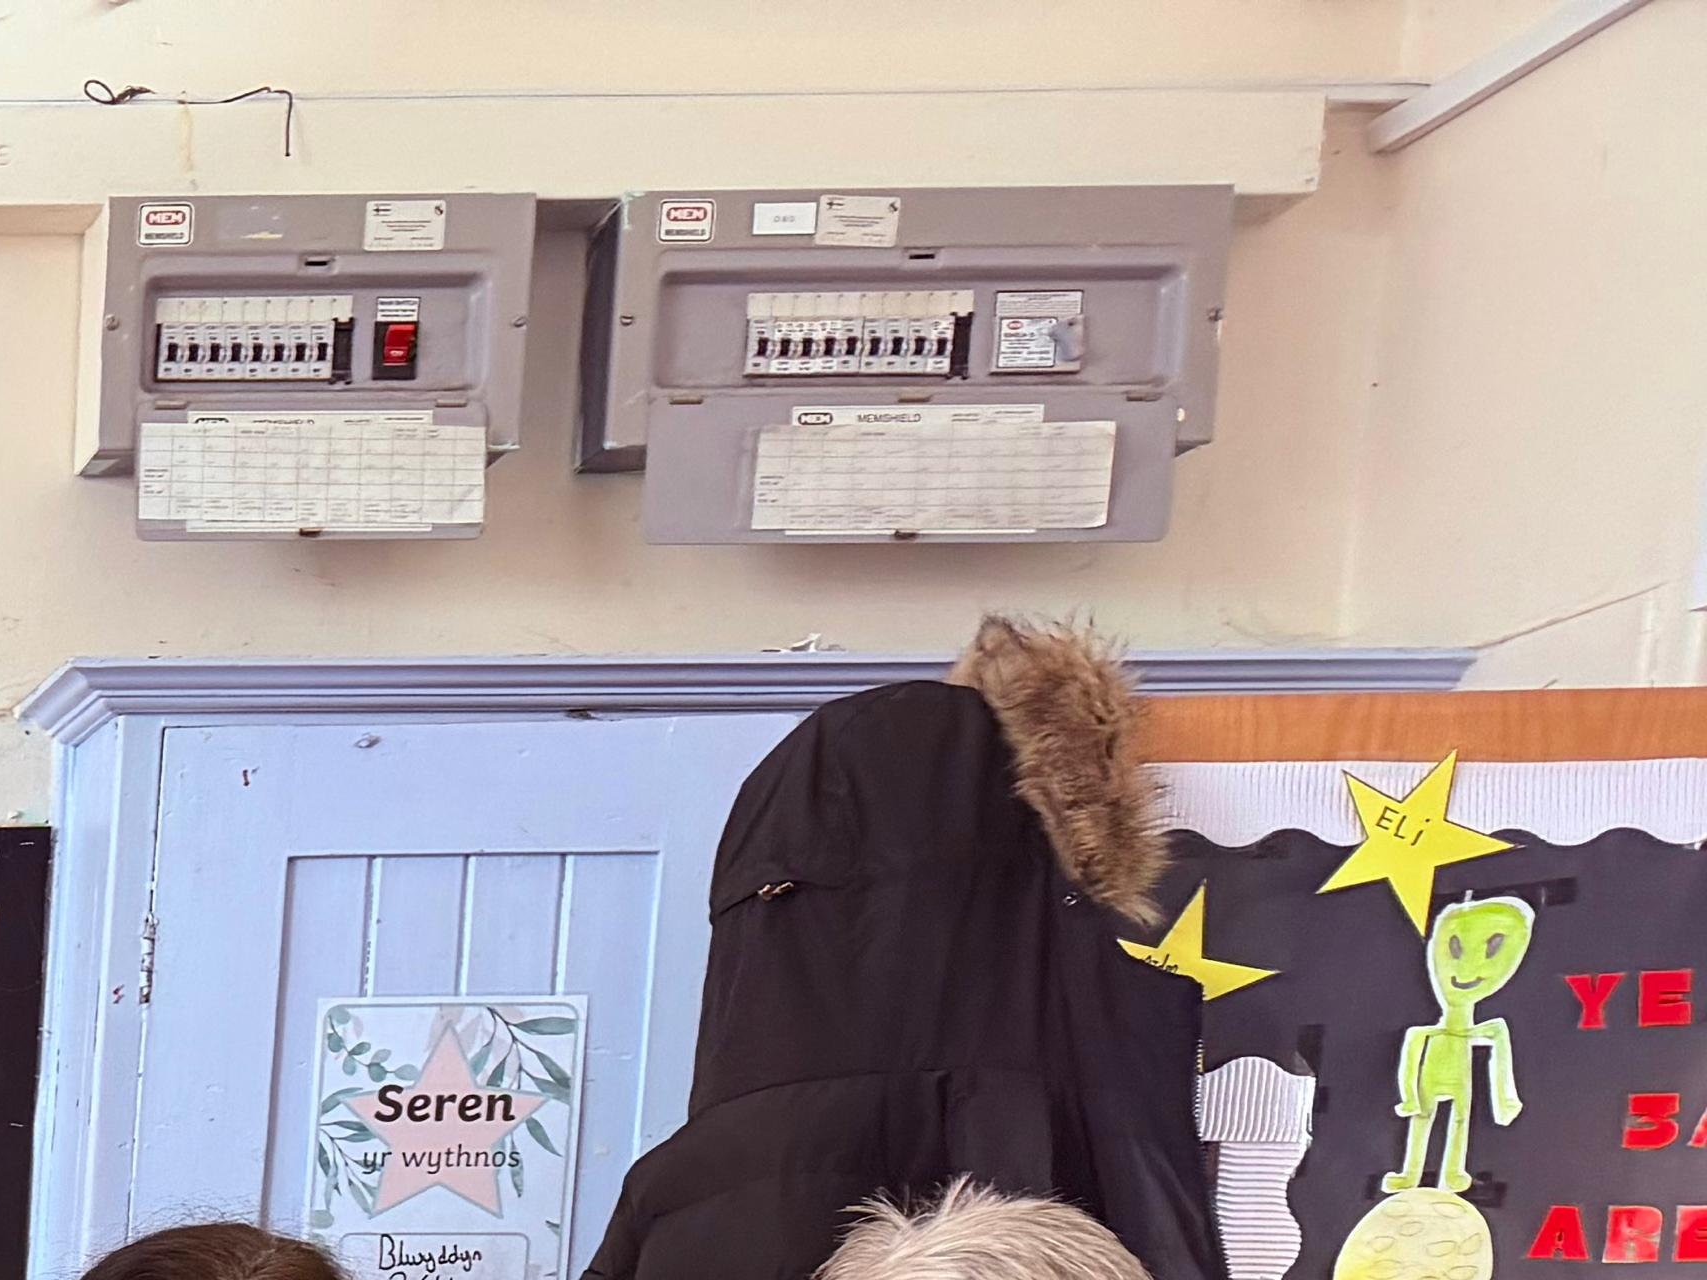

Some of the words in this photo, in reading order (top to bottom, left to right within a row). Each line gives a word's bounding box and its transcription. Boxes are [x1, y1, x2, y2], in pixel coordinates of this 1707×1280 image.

[374, 1084, 516, 1123] Seren
[362, 1148, 392, 1174] yr
[402, 1143, 522, 1175] wythnos
[378, 1233, 483, 1274] Blwyddyn
[1527, 1204, 1707, 1264] ARE
